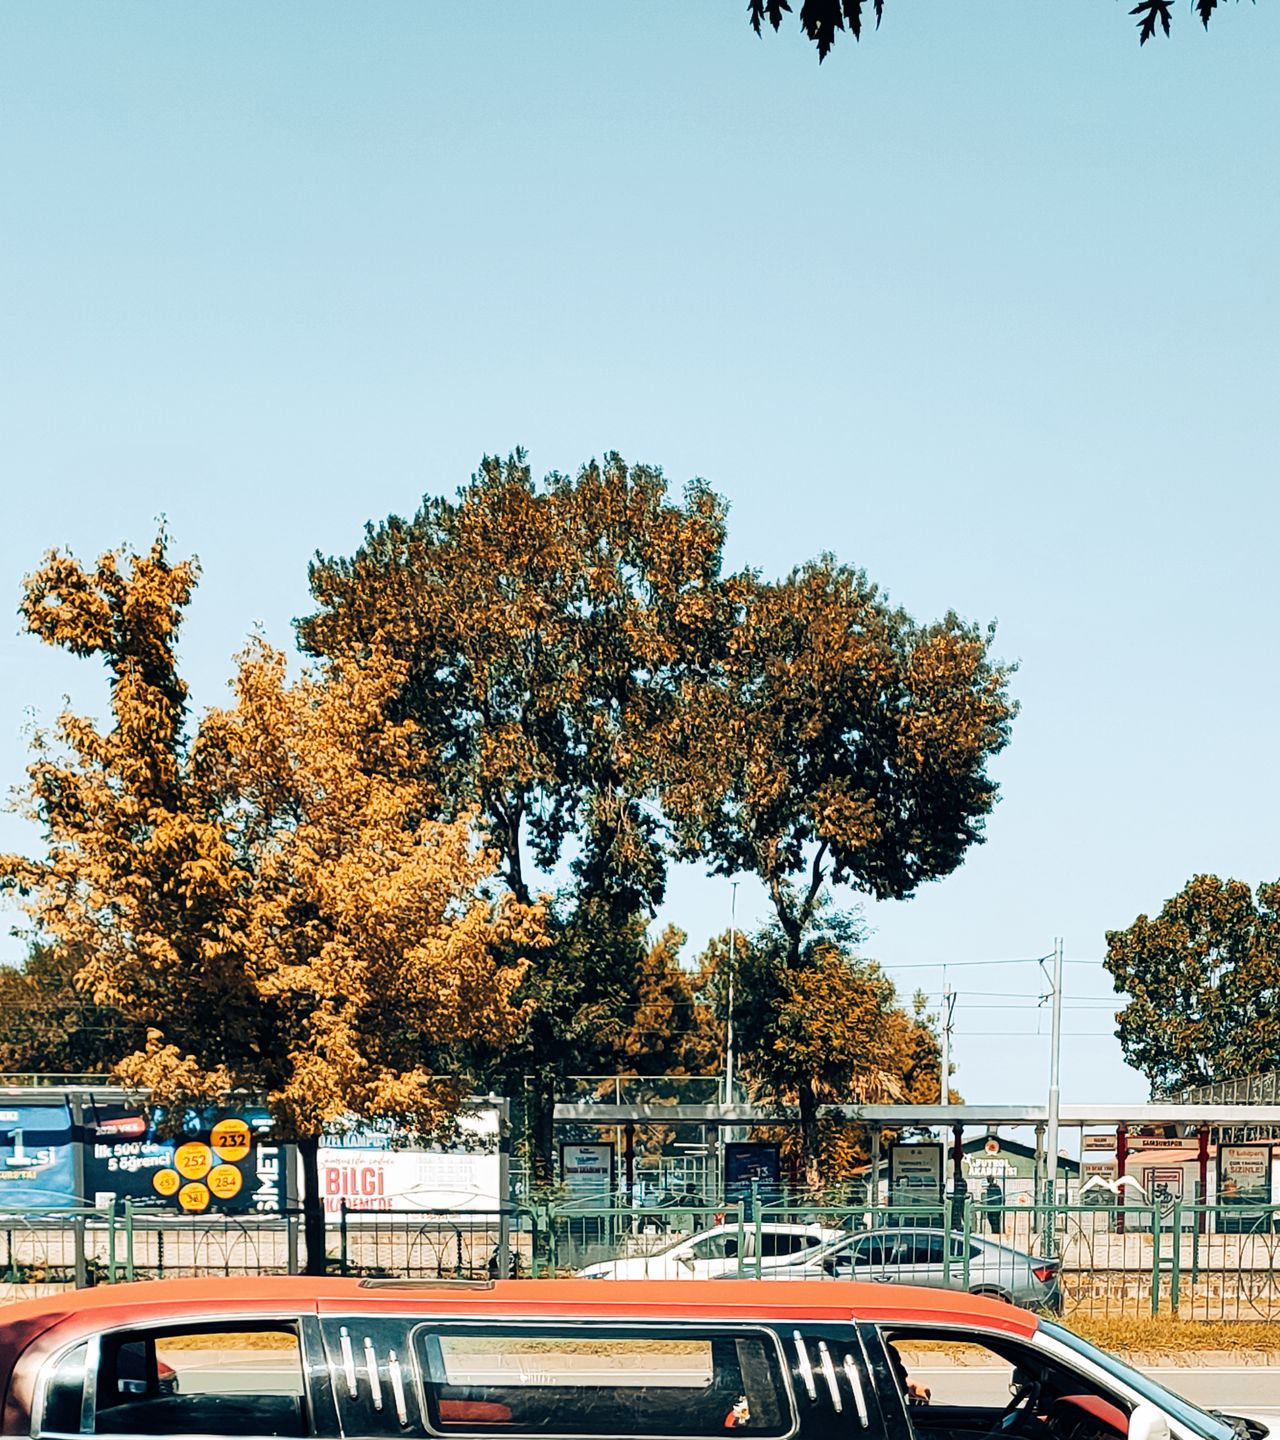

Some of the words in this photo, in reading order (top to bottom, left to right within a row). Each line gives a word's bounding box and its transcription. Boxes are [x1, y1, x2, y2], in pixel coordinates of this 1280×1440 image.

[218, 1133, 246, 1148] 232
[107, 1158, 118, 1172] 5
[183, 1154, 207, 1168] 252
[214, 1176, 237, 1188] 284
[325, 1167, 385, 1196] BİLGİ
